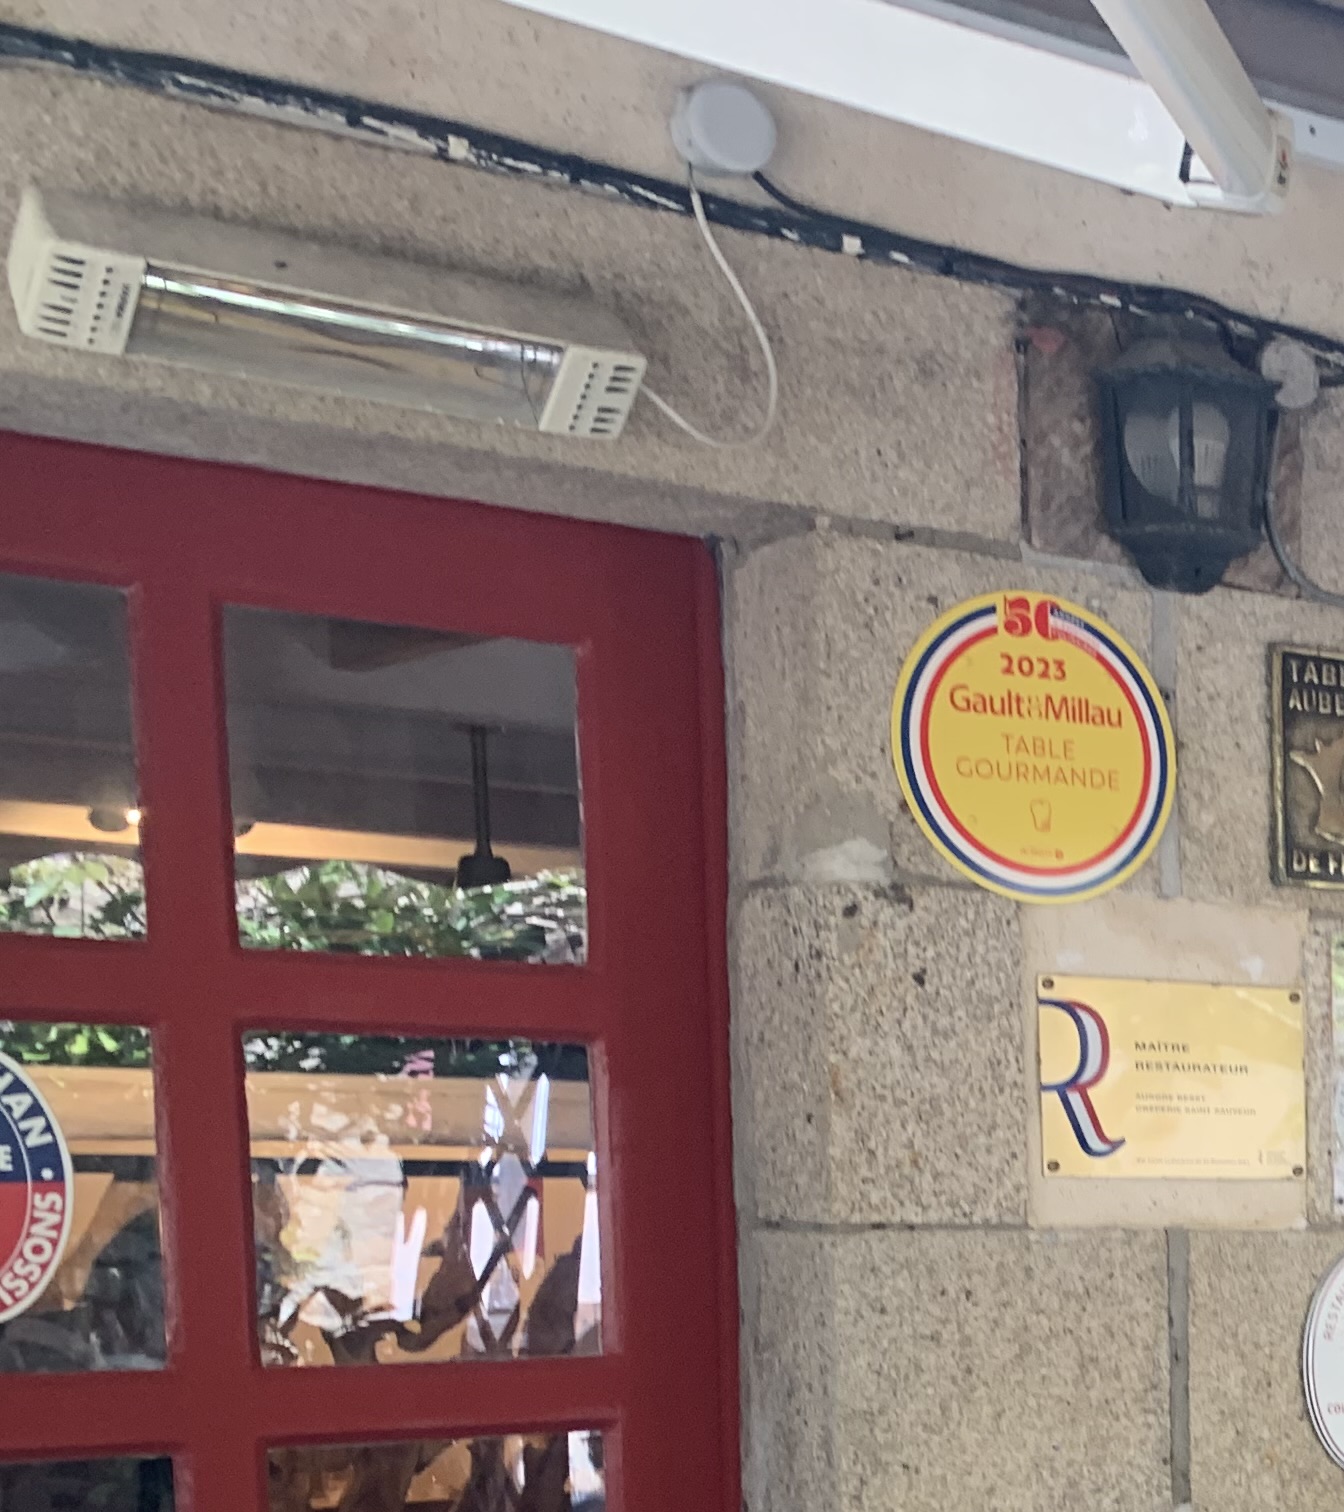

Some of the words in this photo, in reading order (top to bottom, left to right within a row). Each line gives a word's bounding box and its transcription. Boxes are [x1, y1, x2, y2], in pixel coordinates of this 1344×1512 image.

[1000, 652, 1067, 682] 2023
[1002, 732, 1076, 761] TABLE
[955, 756, 1121, 792] GOURMANDE
[1292, 850, 1322, 874] DE
[1134, 1061, 1249, 1077] RESTAURATEUR
